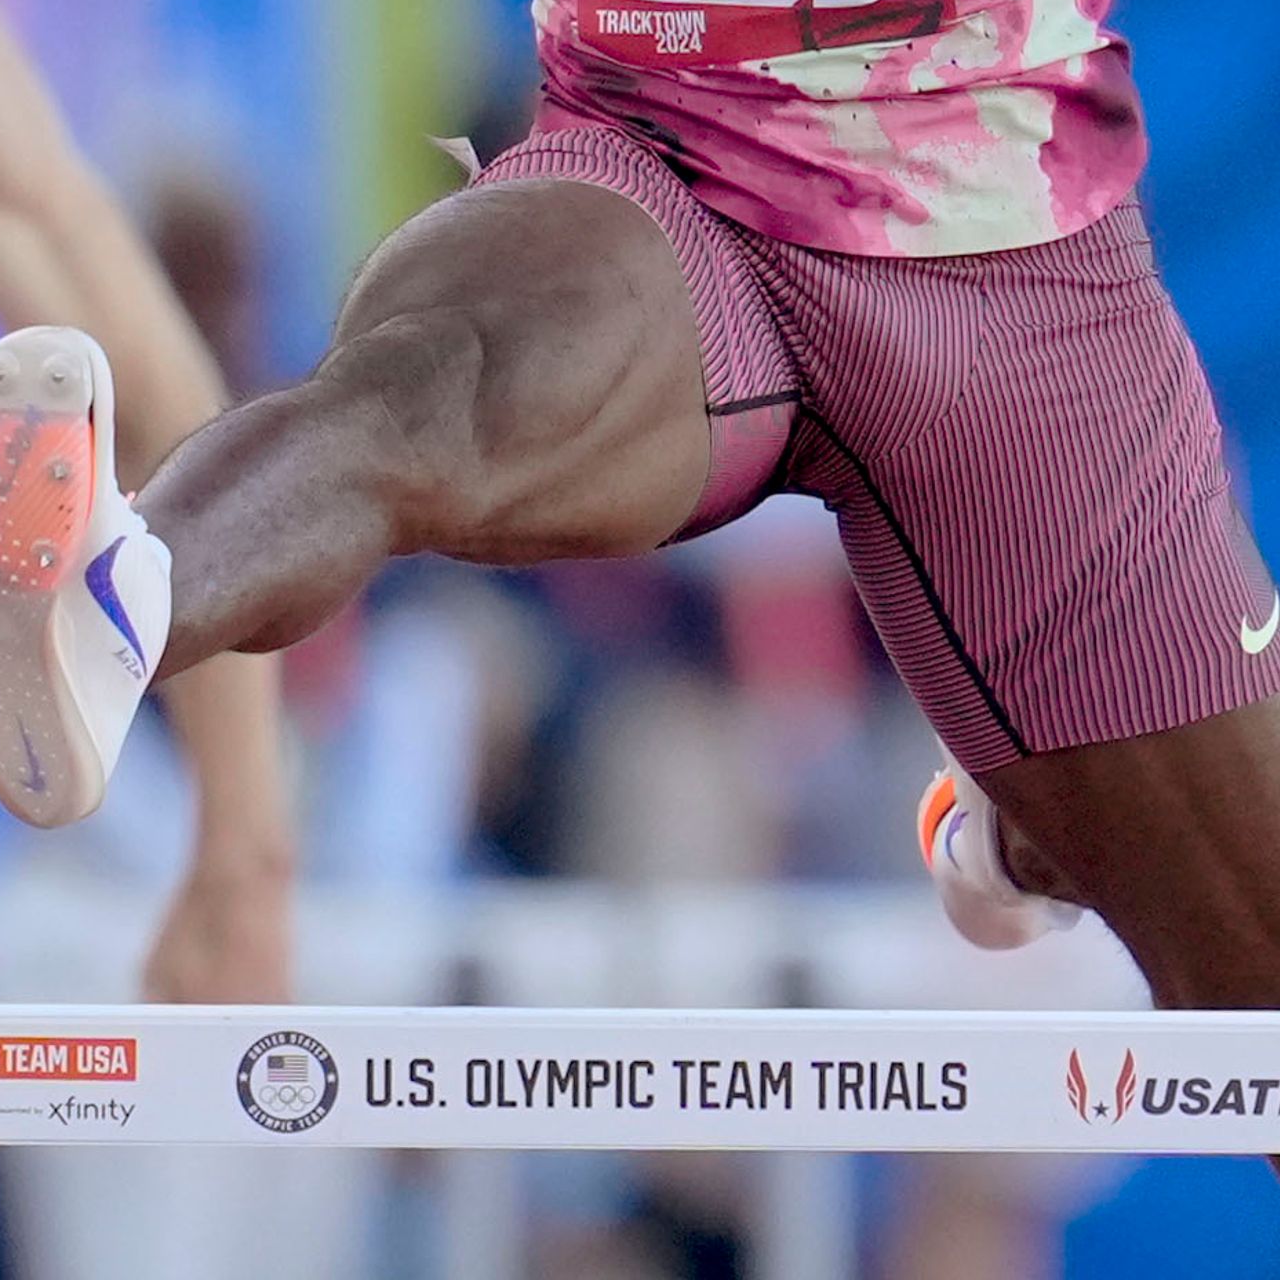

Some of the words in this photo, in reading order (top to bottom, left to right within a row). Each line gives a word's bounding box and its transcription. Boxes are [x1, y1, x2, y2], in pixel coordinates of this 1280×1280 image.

[595, 9, 706, 39] TRACKTOWN
[656, 29, 703, 54] 2024
[2, 1044, 68, 1073] TEAM
[77, 1045, 128, 1074] USA
[366, 1058, 447, 1108] U.S.
[466, 1059, 654, 1109] OLYMPIC
[672, 1060, 792, 1110] TEAM
[811, 1061, 967, 1111] TRIALS
[48, 1096, 135, 1126] xfinity
